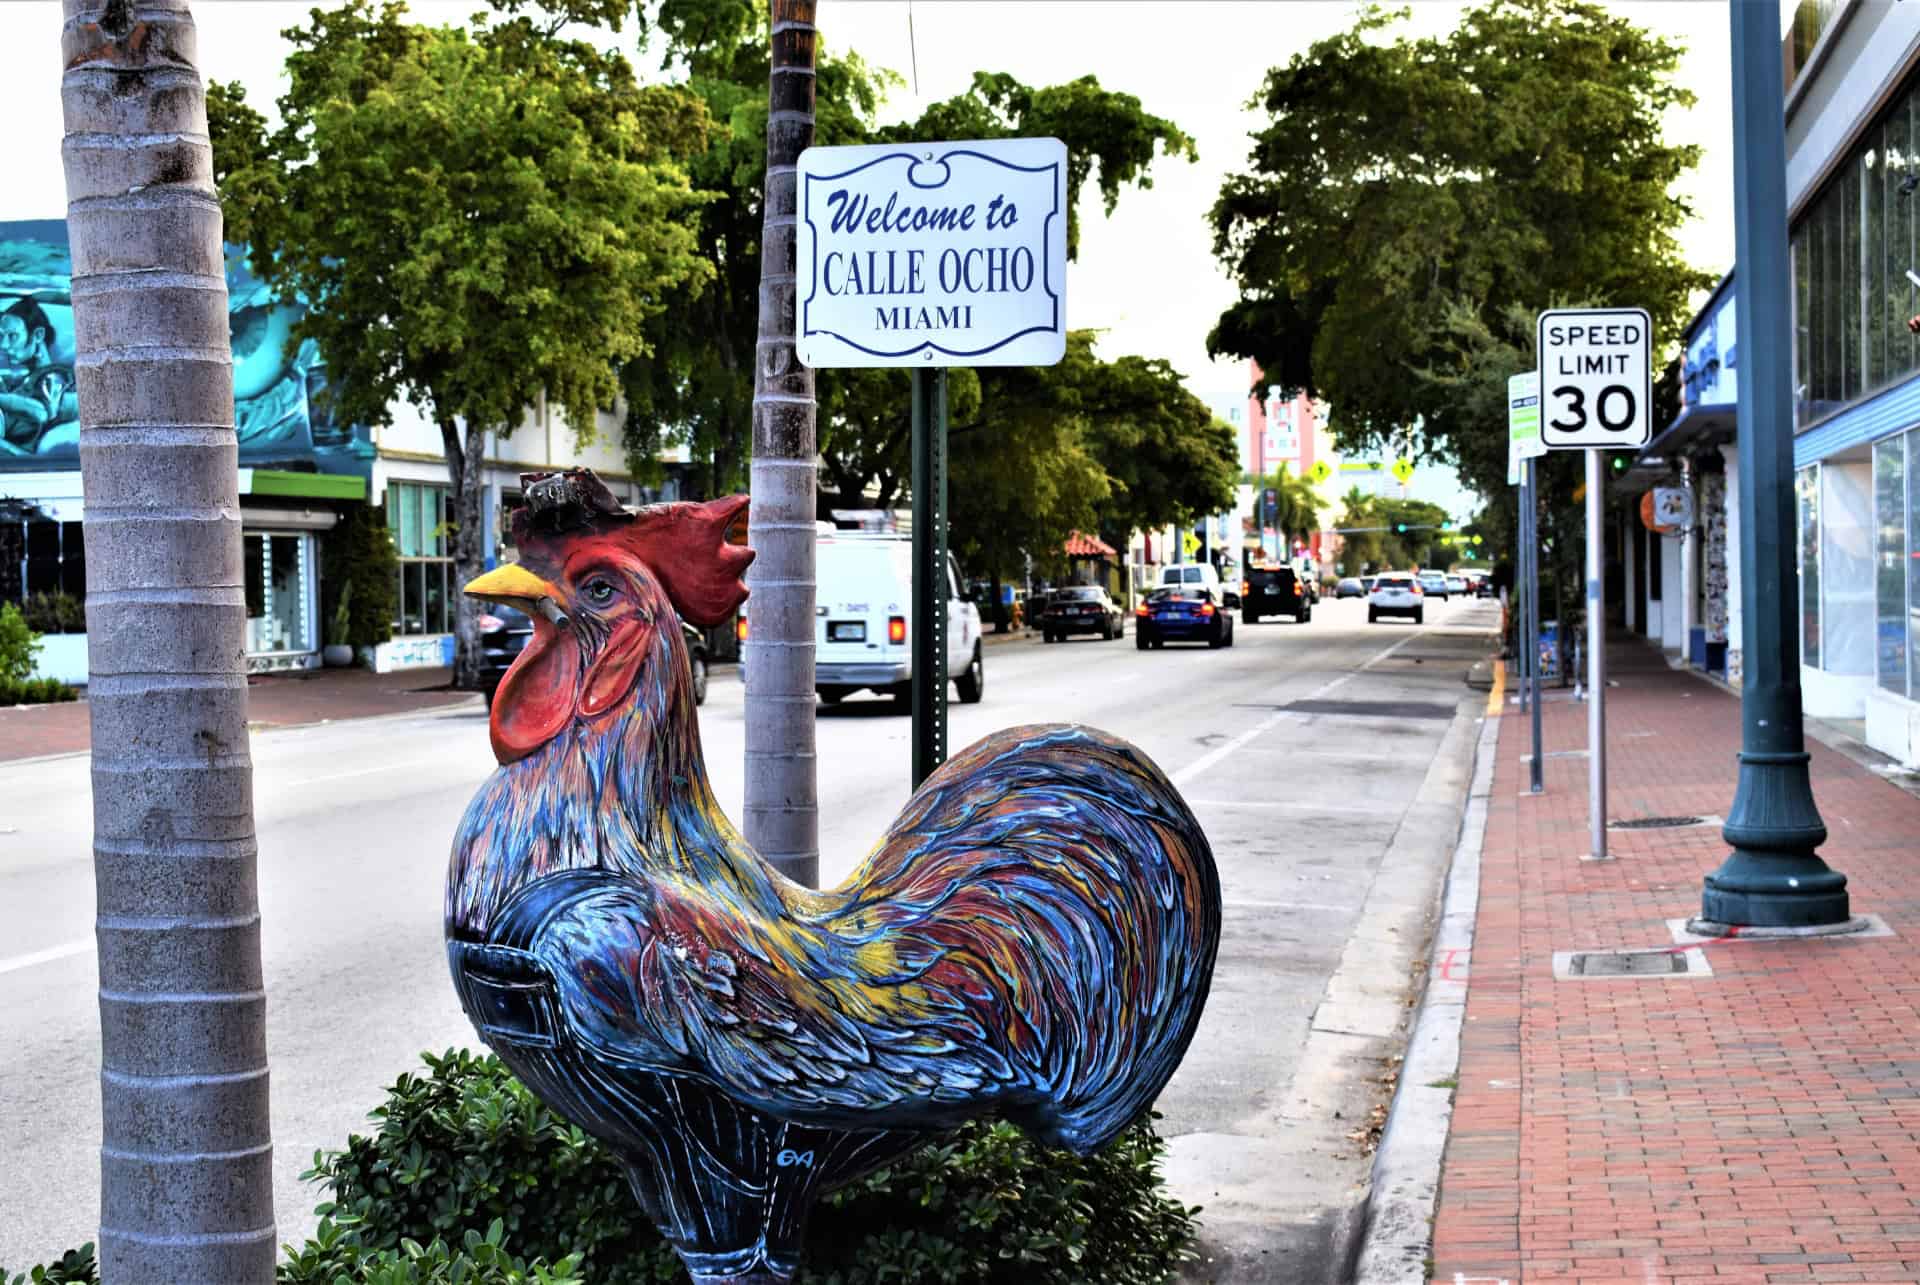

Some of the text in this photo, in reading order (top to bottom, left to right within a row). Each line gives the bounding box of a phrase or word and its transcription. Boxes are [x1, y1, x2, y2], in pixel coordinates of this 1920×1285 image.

[826, 187, 1019, 234] Welcome to
[823, 245, 1035, 297] CALLE OCHO
[875, 305, 972, 330] MIAMI
[1549, 325, 1640, 346] SPEED
[1559, 354, 1630, 376] LIMIT
[1550, 384, 1637, 433] 30
